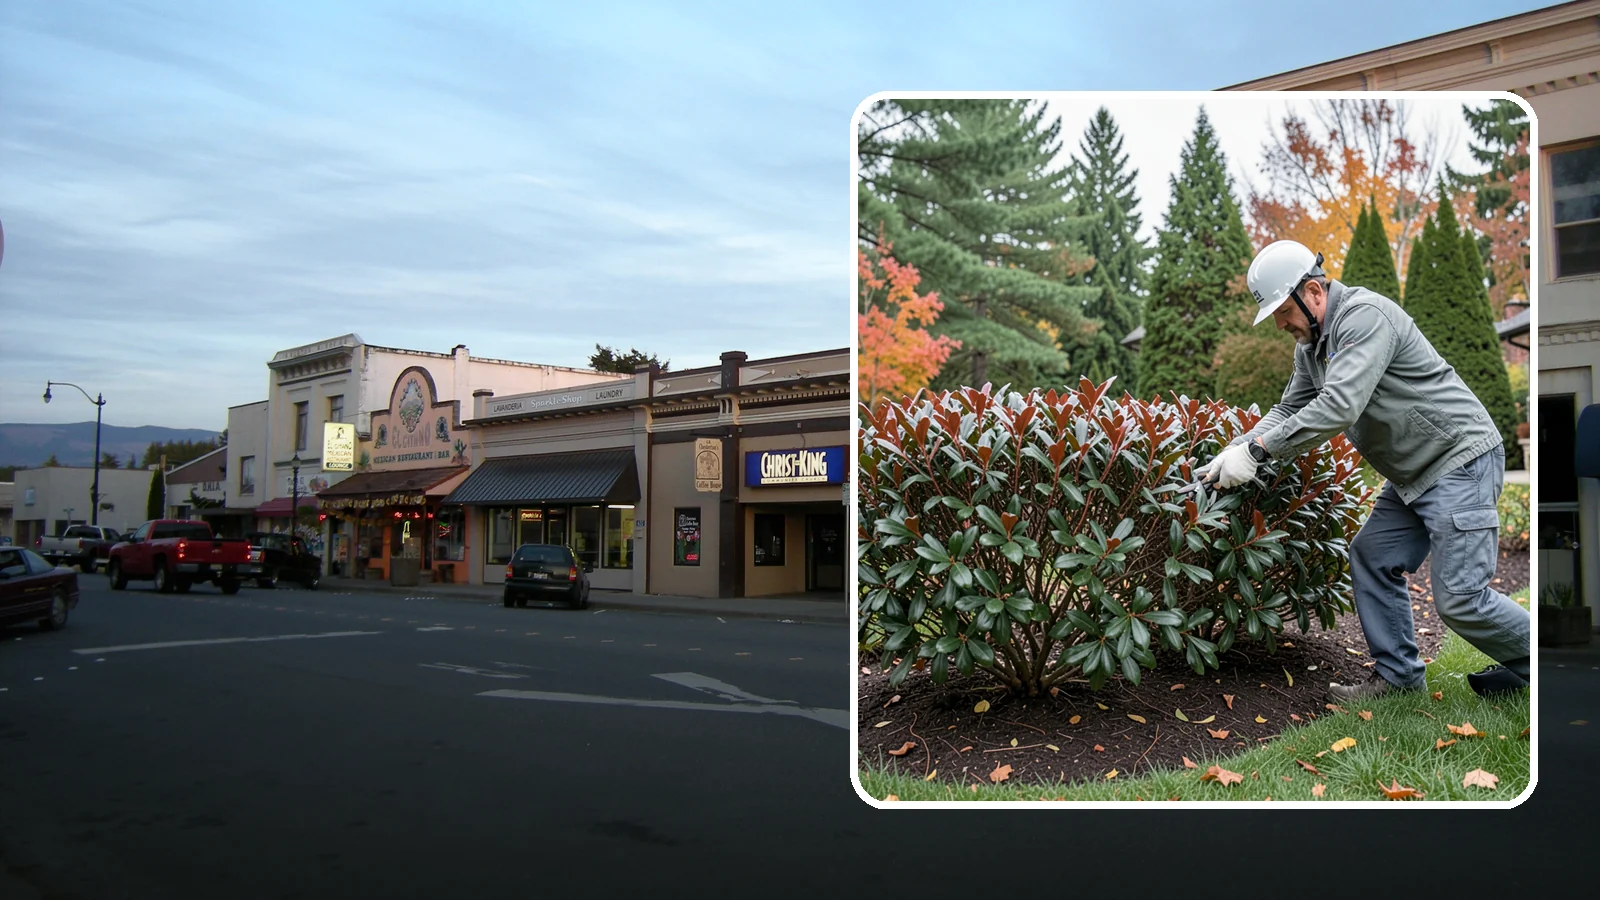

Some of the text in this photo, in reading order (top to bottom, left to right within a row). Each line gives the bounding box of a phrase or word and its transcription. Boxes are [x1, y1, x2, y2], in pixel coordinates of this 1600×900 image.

[561, 394, 582, 405] Shop
[595, 389, 623, 400] LAUNDRY
[493, 402, 523, 412] LAVANDERIA
[373, 454, 396, 464] MEXICAN
[397, 451, 432, 462] RESTAURANT
[437, 450, 449, 459] BAR
[761, 450, 827, 478] CHRIST KING
